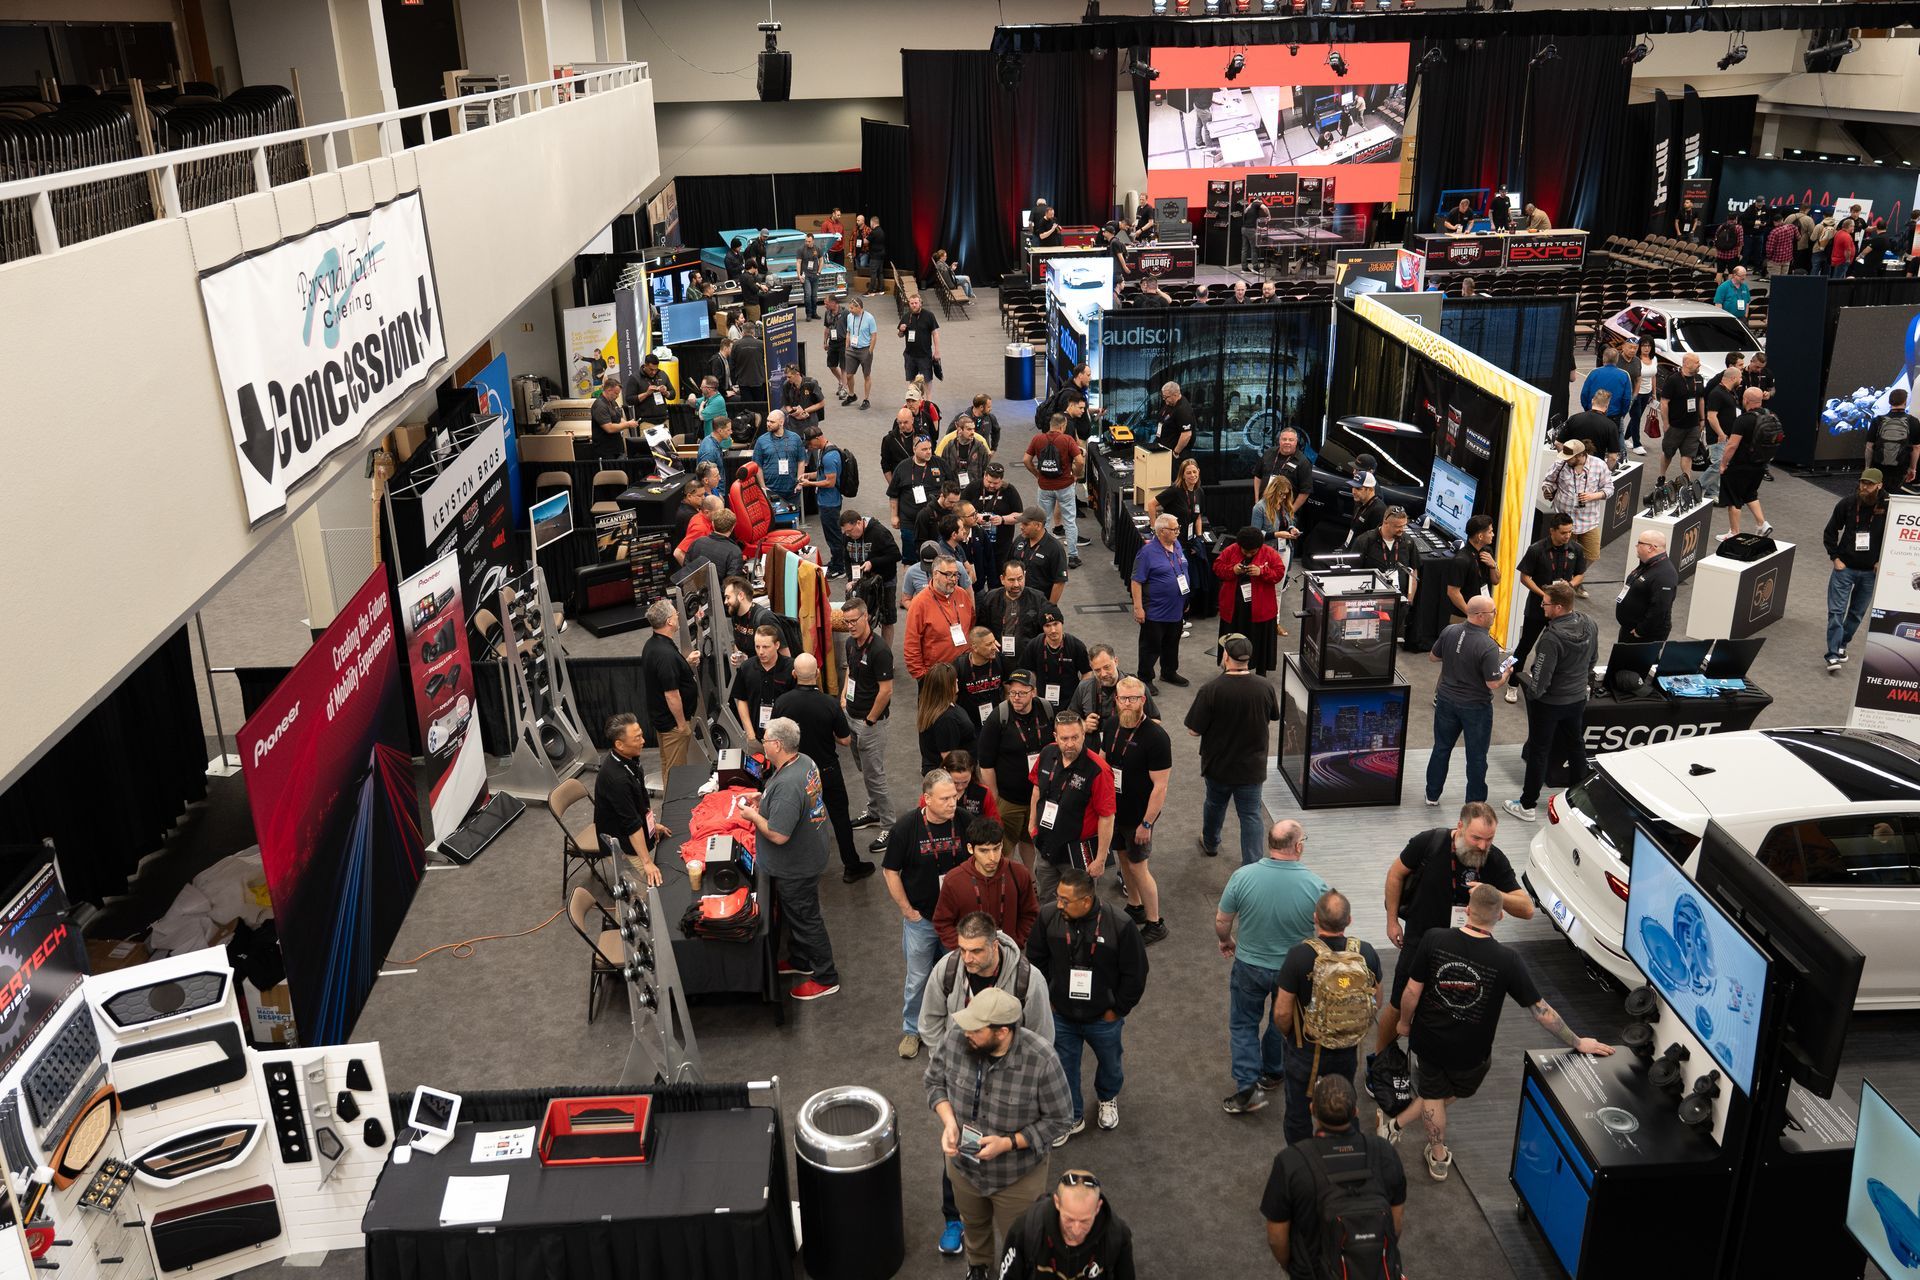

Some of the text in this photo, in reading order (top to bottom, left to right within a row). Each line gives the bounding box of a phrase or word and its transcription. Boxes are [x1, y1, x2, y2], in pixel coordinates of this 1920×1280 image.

[1451, 247, 1480, 257] BUILD OFF
[1510, 247, 1582, 259] EXPO
[1141, 257, 1171, 268] BUILD OFF
[1103, 326, 1181, 345] audison
[432, 474, 474, 532] KEYSTON
[477, 447, 500, 481] BROS
[599, 513, 633, 525] ALCANTARA
[418, 569, 441, 588] Pioneer
[333, 591, 388, 671] Creating the Future
[326, 622, 391, 721] of Mobility Experiences
[1866, 676, 1919, 689] THE DRIVING
[254, 701, 300, 768] Pioneer
[8, 869, 54, 920] SMART SOLUTIONS
